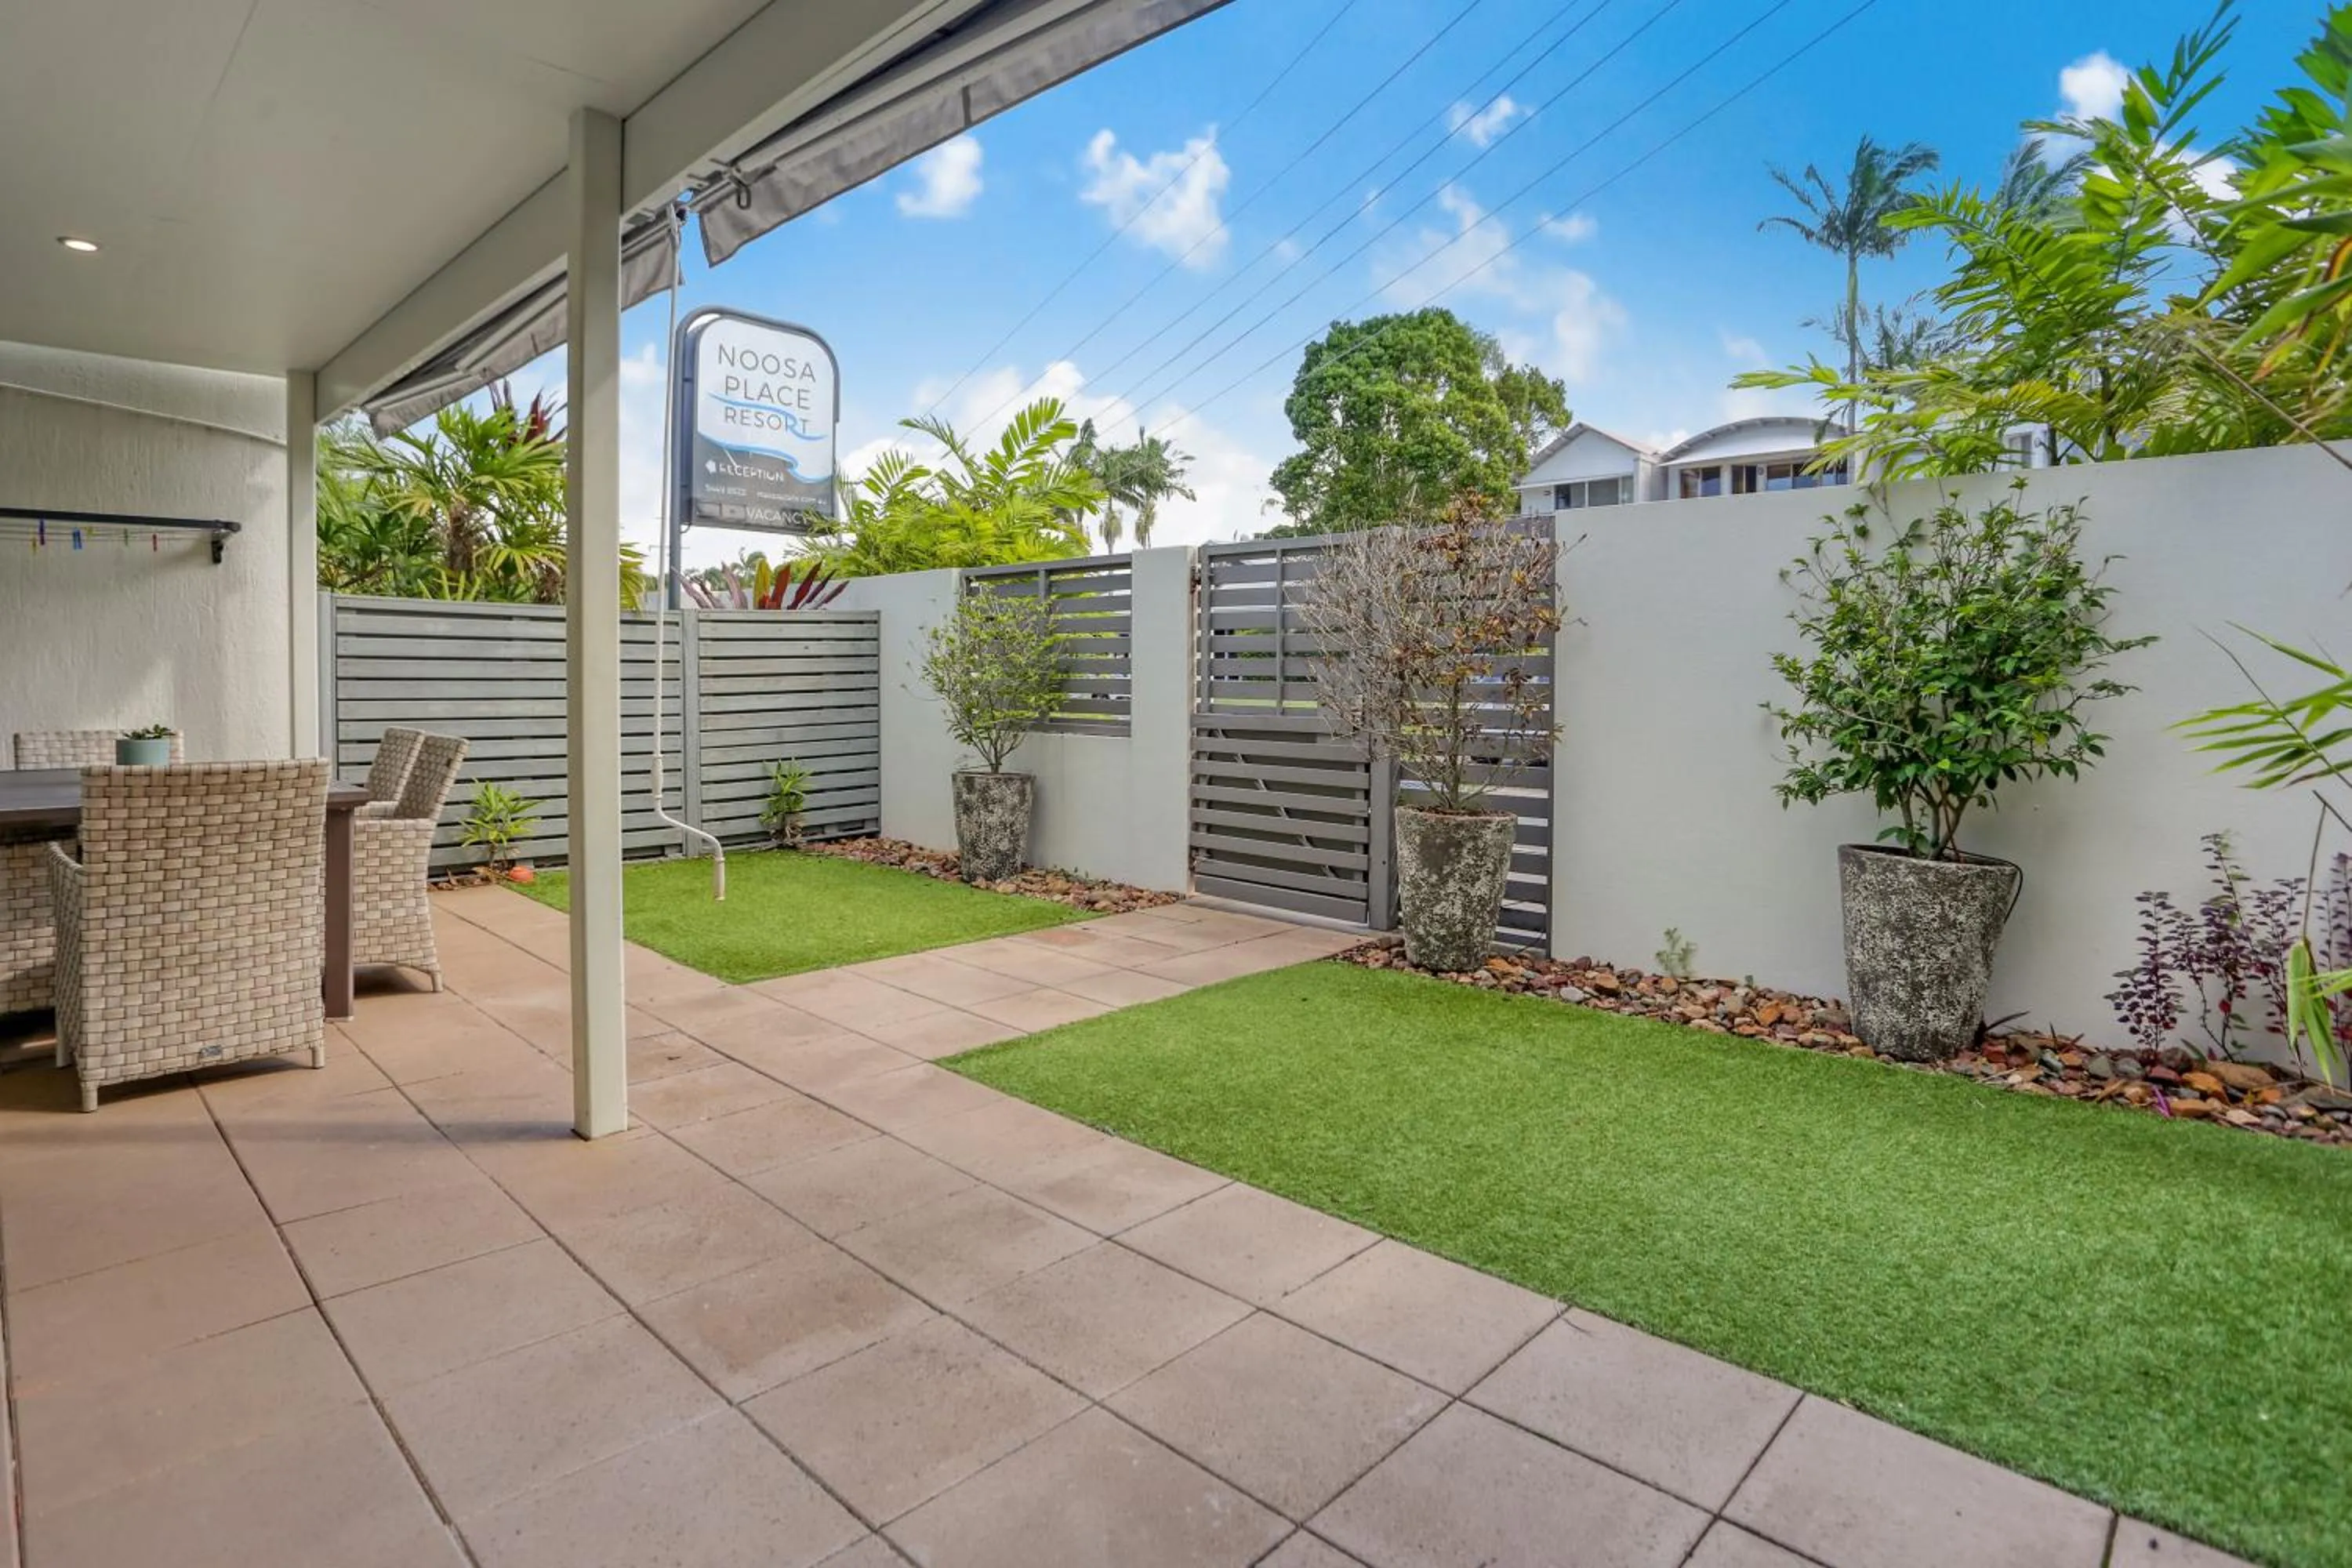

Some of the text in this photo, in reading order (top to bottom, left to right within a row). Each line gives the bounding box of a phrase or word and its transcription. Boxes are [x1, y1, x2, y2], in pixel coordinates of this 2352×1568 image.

[718, 343, 816, 383] NOOSA
[725, 376, 811, 410] PLACE
[724, 406, 811, 434] RESORT
[718, 465, 784, 481] RECEPTION
